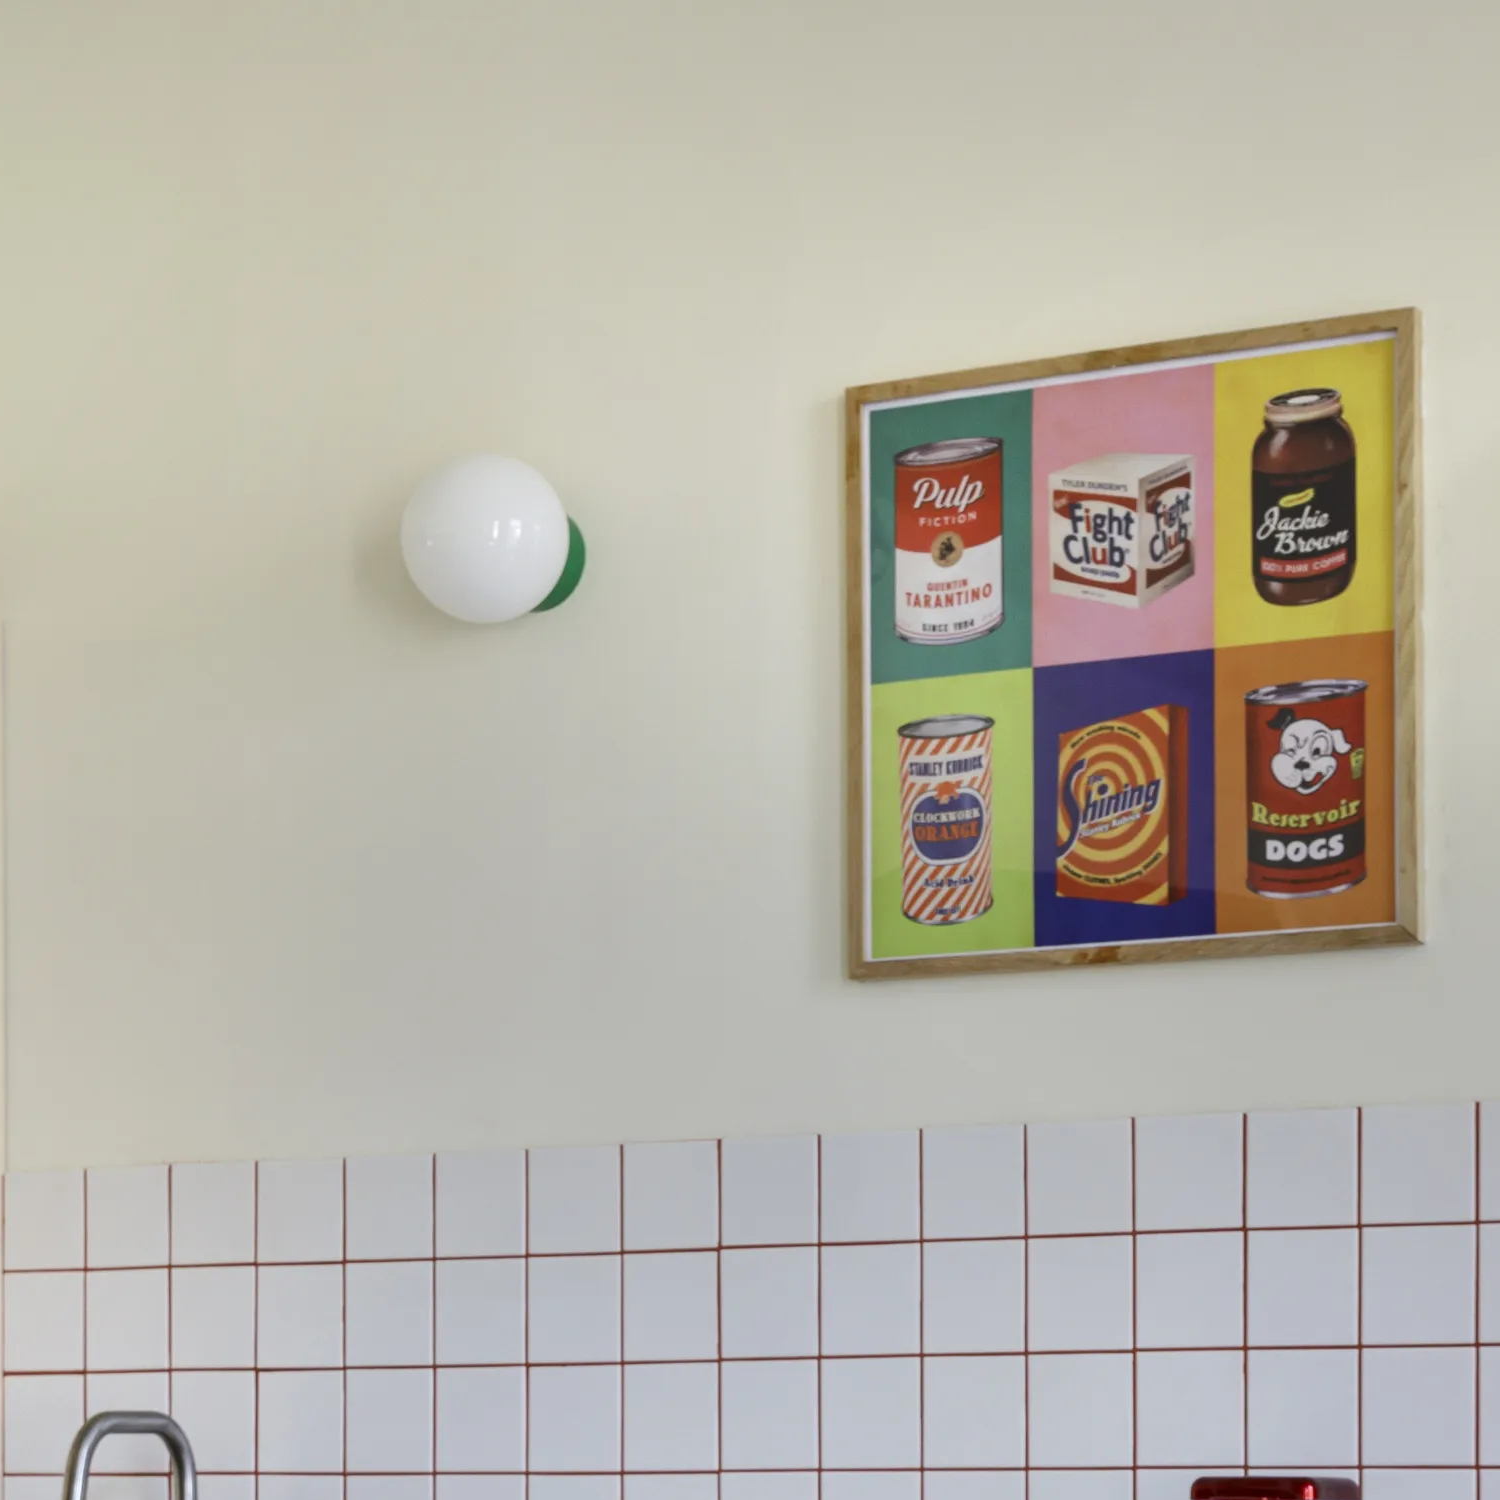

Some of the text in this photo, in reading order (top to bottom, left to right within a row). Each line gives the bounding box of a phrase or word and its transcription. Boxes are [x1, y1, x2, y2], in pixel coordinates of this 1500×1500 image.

[913, 475, 984, 512] Pulp
[919, 512, 977, 527] FICTION
[1070, 503, 1134, 543] Fight
[1154, 492, 1190, 532] Fight
[1257, 506, 1329, 541] Jackie
[1063, 535, 1124, 568] Club
[1150, 519, 1187, 562] Club
[1275, 530, 1349, 555] Brown
[905, 584, 992, 609] TARANTINO
[927, 579, 968, 592] QUENTIN
[922, 622, 948, 633] SINCE
[909, 761, 943, 777] STANLEY
[913, 808, 980, 824] CLOCKWORK
[1057, 758, 1163, 861] Shining
[1252, 799, 1361, 828] Reservoir
[914, 821, 980, 842] ORANGE
[1266, 834, 1344, 863] DOGS
